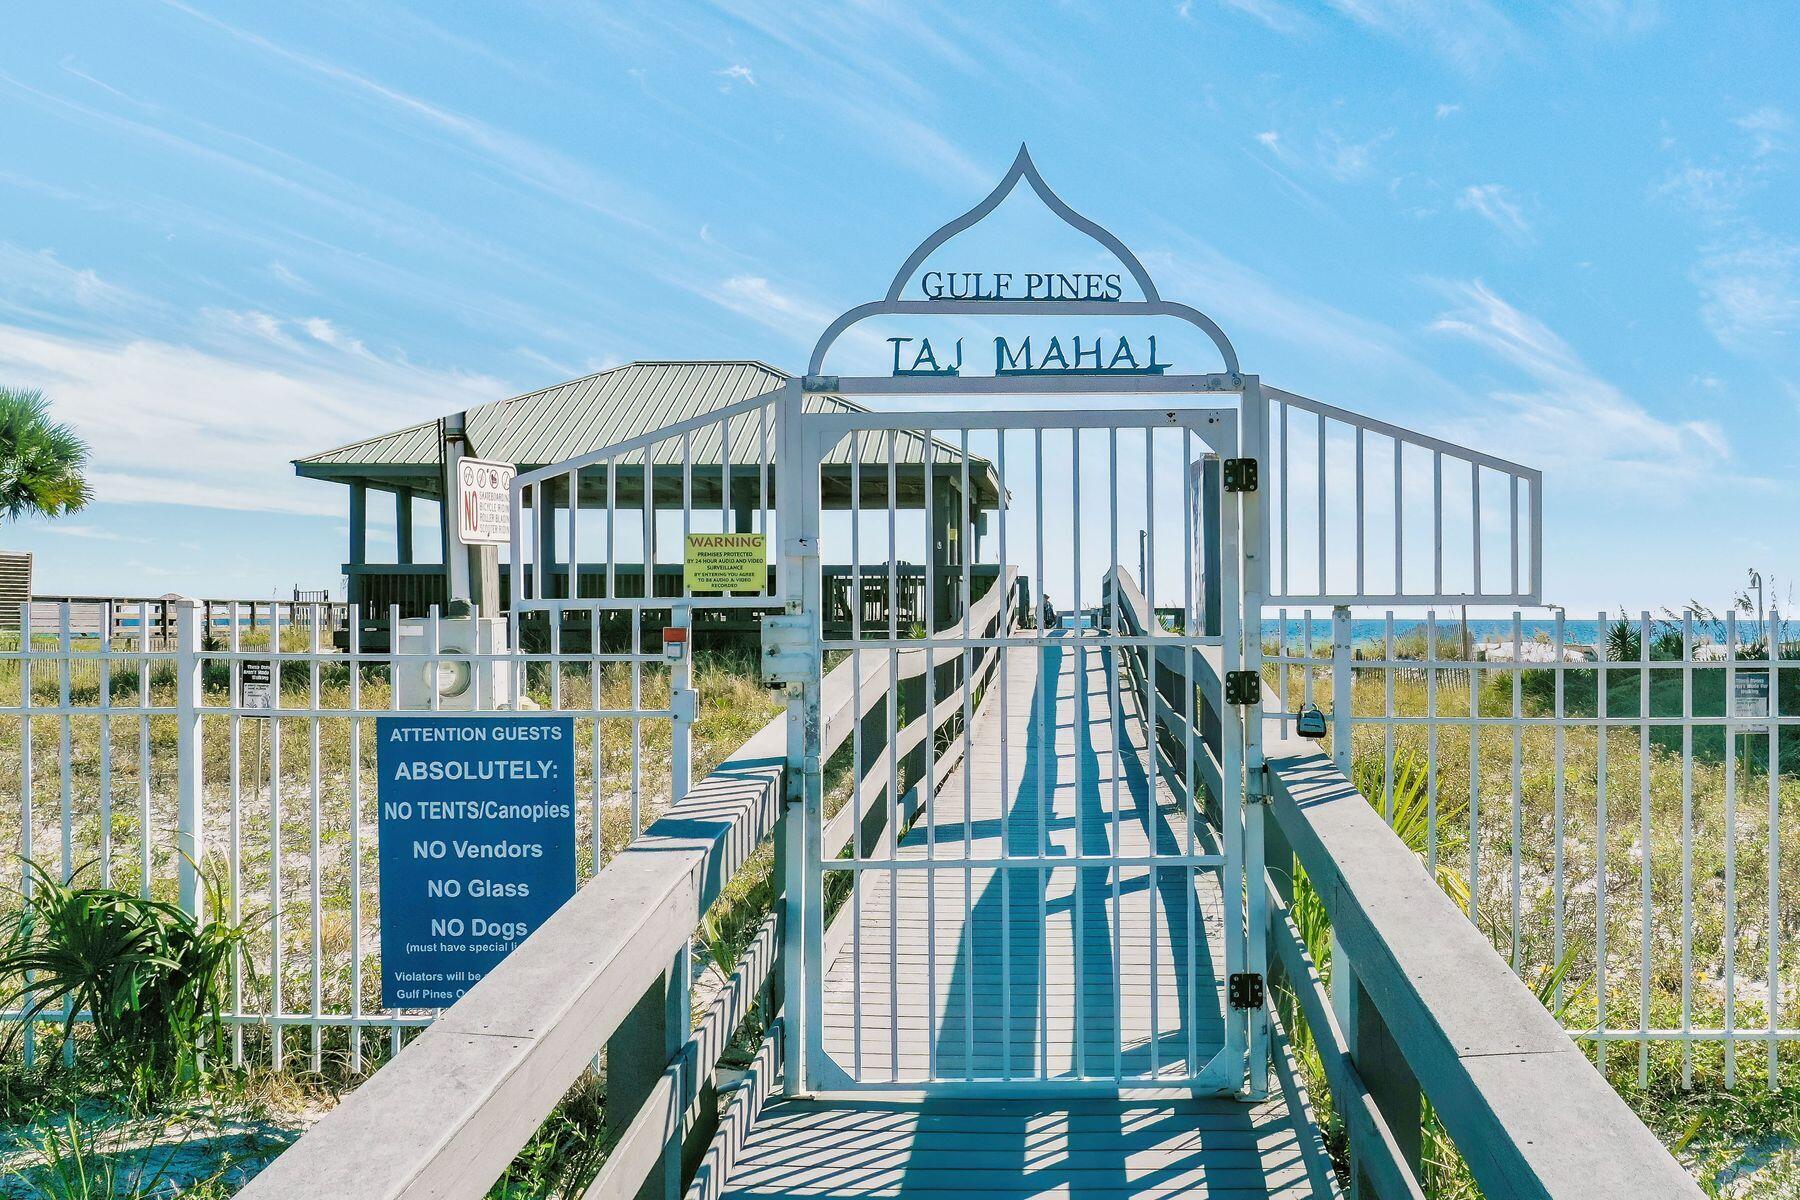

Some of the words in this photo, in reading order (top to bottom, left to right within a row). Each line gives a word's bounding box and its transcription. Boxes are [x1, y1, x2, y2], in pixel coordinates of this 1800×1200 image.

[921, 271, 1013, 299] GULF
[1024, 273, 1122, 300] PINES
[886, 337, 963, 372] TAJ
[993, 335, 1173, 372] MAHAL
[464, 491, 478, 532] NO
[689, 536, 762, 548] WARNING
[390, 727, 486, 742] ATTENTION
[492, 726, 562, 741] GUESTS
[394, 760, 558, 781] ABSOLUTELY:
[384, 802, 412, 820] NO
[417, 800, 571, 822] TENTS/Canopies
[413, 840, 446, 859] NO
[453, 840, 543, 859] Vendors
[428, 879, 461, 898] NO
[467, 879, 530, 898] Glass
[431, 918, 465, 937] NO
[471, 918, 528, 941] Dogs
[406, 942, 437, 954] (must
[440, 942, 466, 952] have
[469, 942, 508, 954] special
[395, 972, 443, 981] Violators
[446, 971, 465, 981] will
[467, 971, 481, 981] be
[396, 989, 420, 999] Gulf
[422, 989, 453, 999] Pines
